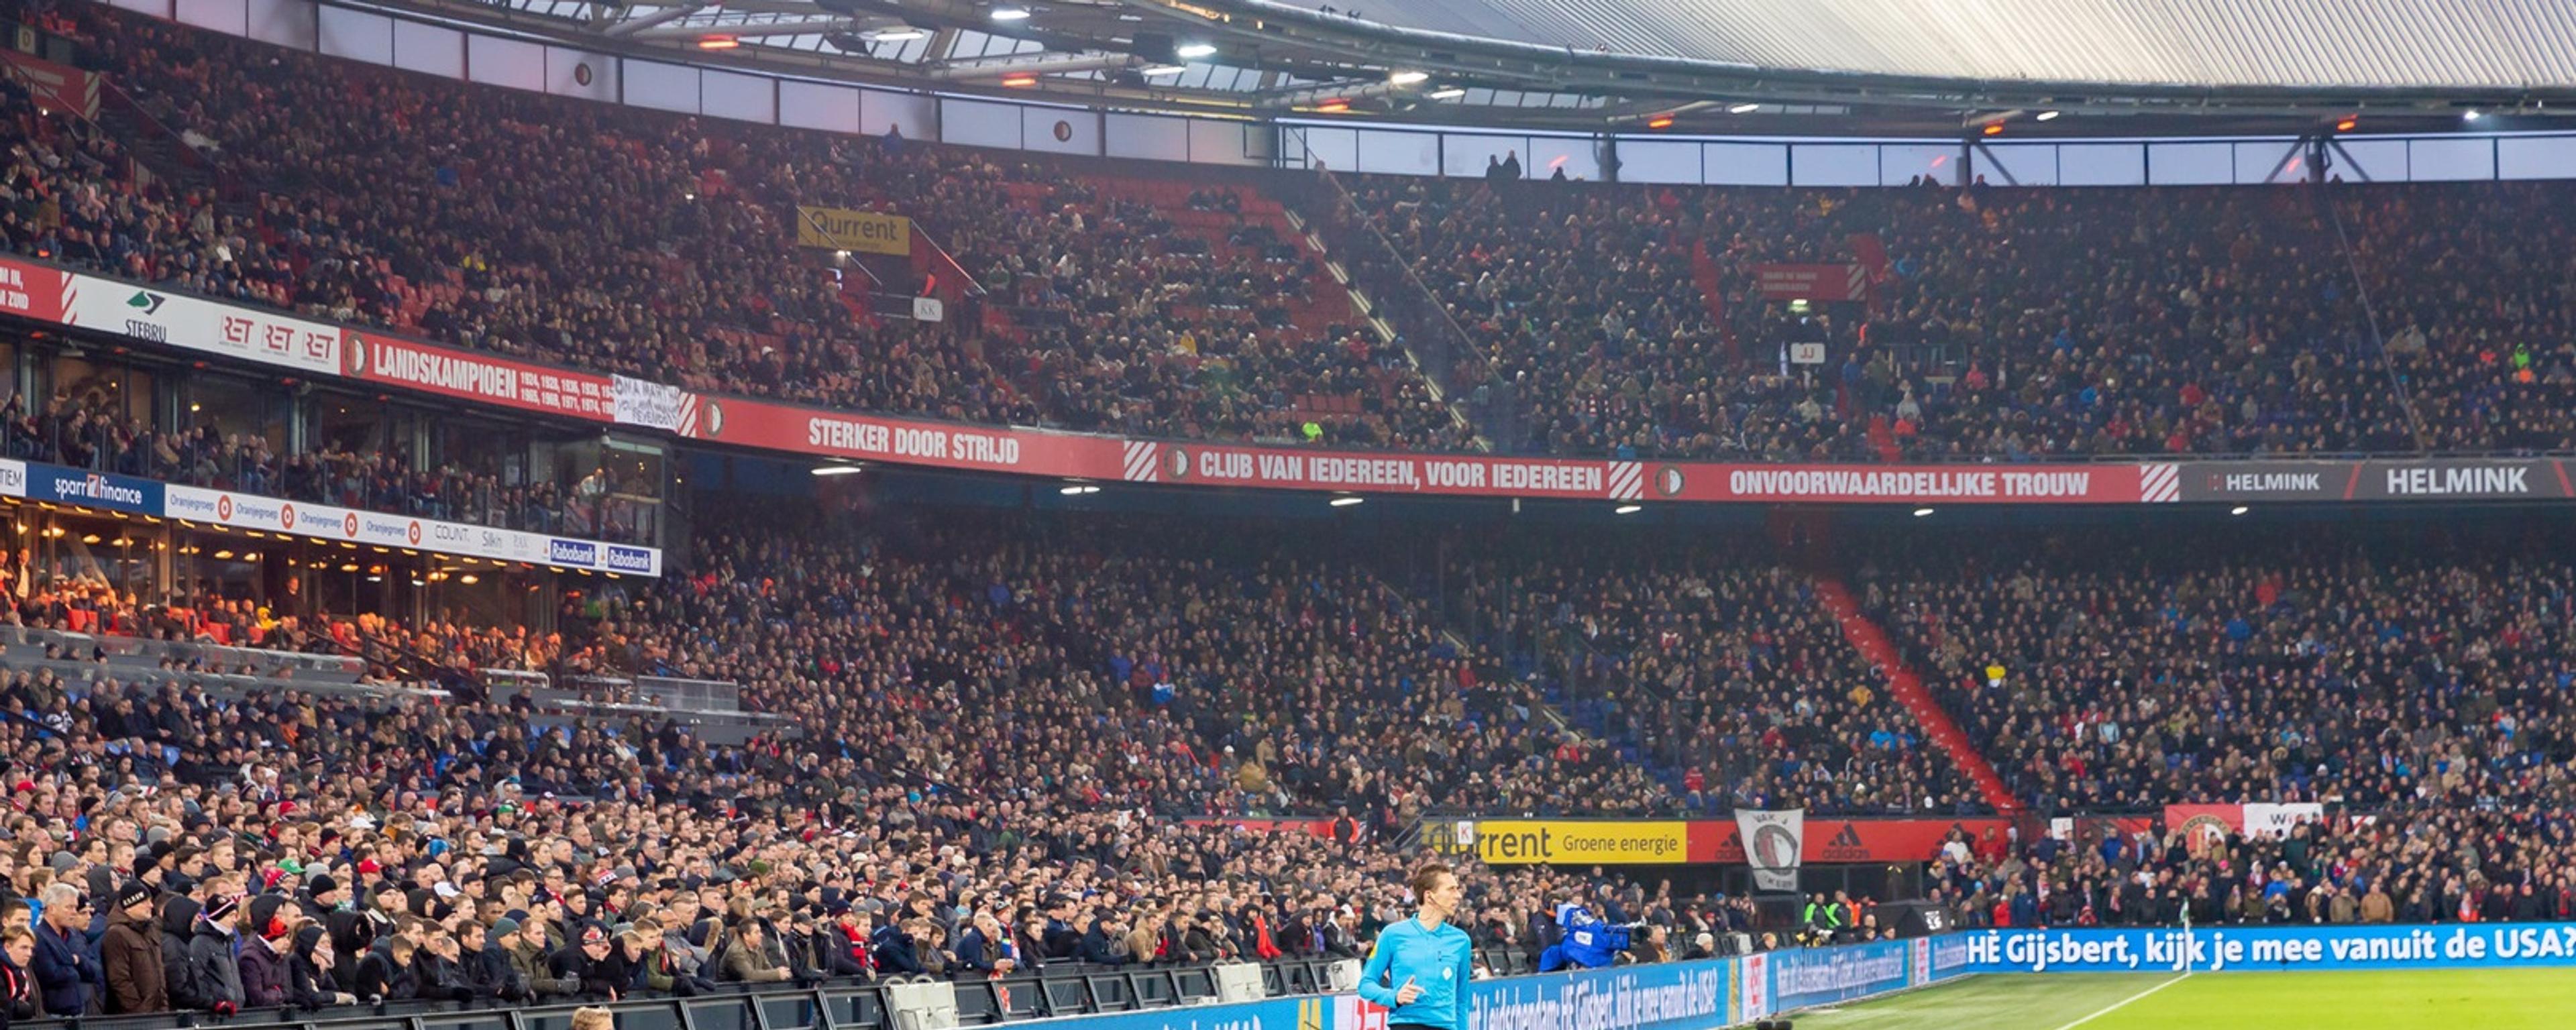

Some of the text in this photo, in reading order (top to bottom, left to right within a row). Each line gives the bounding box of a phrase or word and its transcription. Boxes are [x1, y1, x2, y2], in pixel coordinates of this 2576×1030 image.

[811, 211, 898, 241] Qurrent
[125, 319, 167, 343] STEBRU
[224, 316, 254, 344] RET
[266, 324, 294, 352] RET
[307, 332, 335, 359] RET
[1800, 347, 1815, 359] JJ
[373, 343, 518, 400] LANDSKAMPIOEN
[809, 418, 1019, 465] STERKER DOOR STRIJD
[1199, 451, 1602, 492] CLUB VAN IEDEREEN, VOOR IEDEREEN
[1729, 469, 2090, 496] ONVOORWAARDELIJKE TROUW
[2226, 473, 2321, 492] HELMINK
[2387, 467, 2528, 494] HELMINK
[55, 477, 143, 504] sparr finance
[170, 494, 215, 512] Oranjegroep
[236, 503, 278, 521] Oranjegroep
[301, 512, 342, 529] Oranjegroep
[366, 520, 406, 536] Oranjegroep
[551, 539, 595, 565] Rabobank
[608, 547, 650, 569] Rabobank
[1461, 826, 1470, 839] K
[1563, 835, 1615, 852] Groene
[1620, 835, 1678, 857] energie
[2006, 931, 2139, 972] Gijsbert,
[2147, 931, 2206, 972] kijk
[2210, 931, 2244, 971] je
[2251, 938, 2322, 962] mee
[2330, 928, 2437, 960] vanuit
[2445, 927, 2486, 959] de
[2495, 926, 2576, 958] USA?
